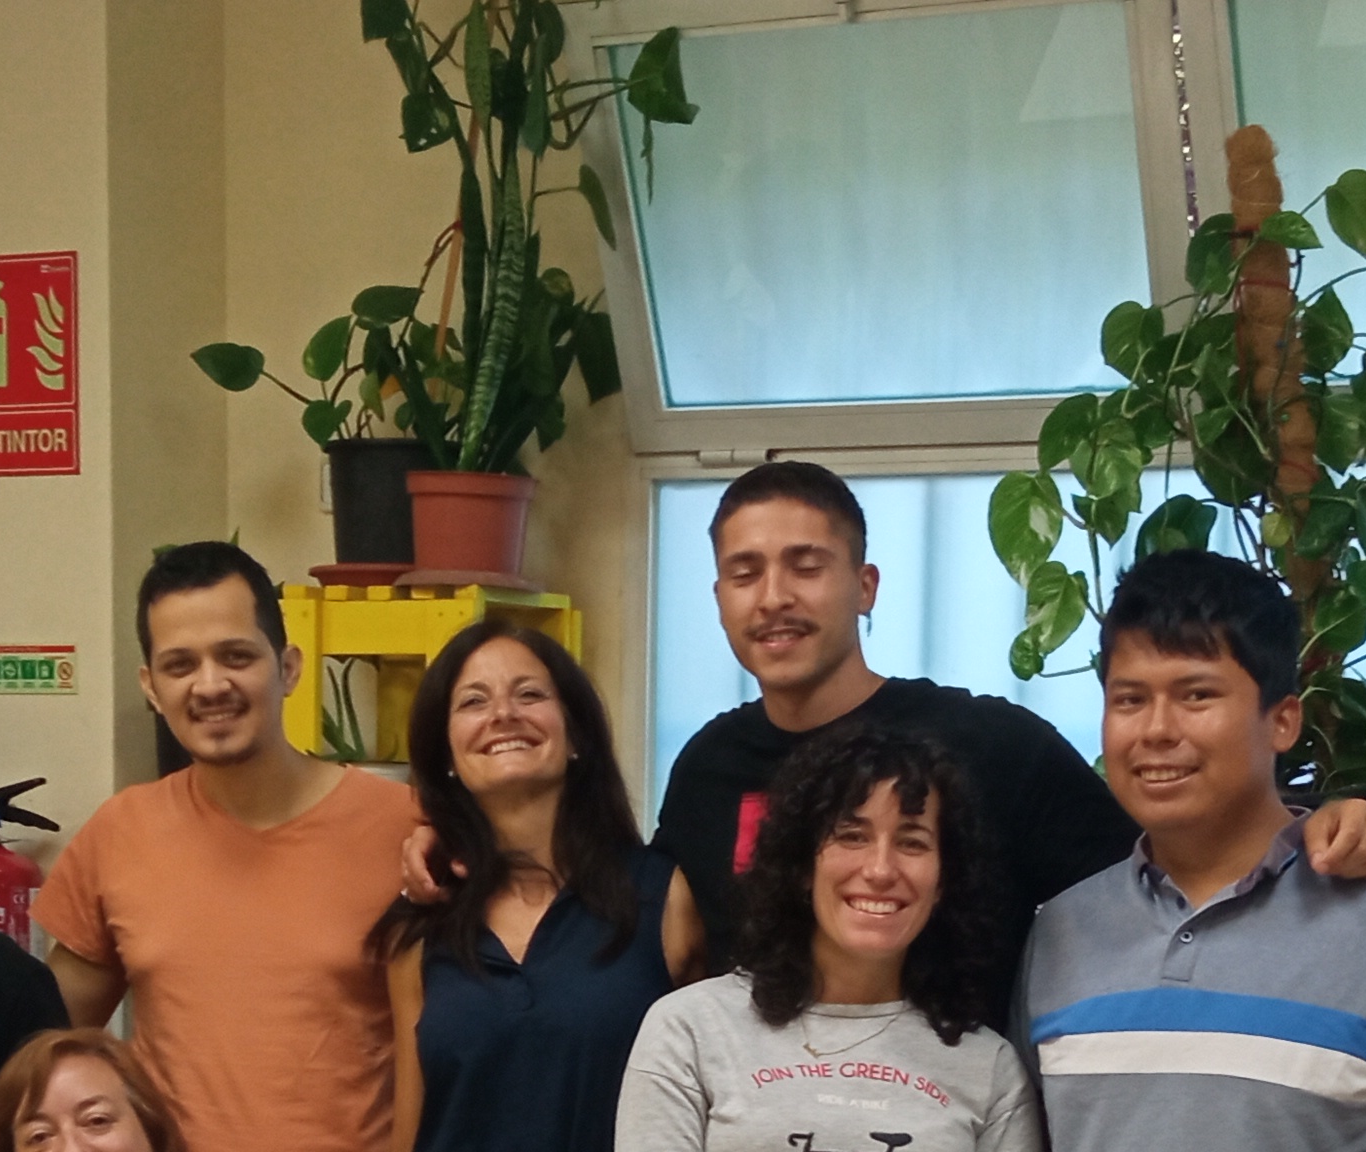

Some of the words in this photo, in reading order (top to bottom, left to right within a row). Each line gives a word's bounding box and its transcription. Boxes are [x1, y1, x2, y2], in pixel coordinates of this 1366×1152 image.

[751, 1066, 794, 1089] JOIN
[795, 1063, 833, 1078] THE
[839, 1062, 910, 1086] GREEN
[914, 1076, 951, 1108] SIDE
[818, 1094, 845, 1106] RIDE
[849, 1099, 859, 1108] A
[862, 1100, 890, 1111] BIKE
